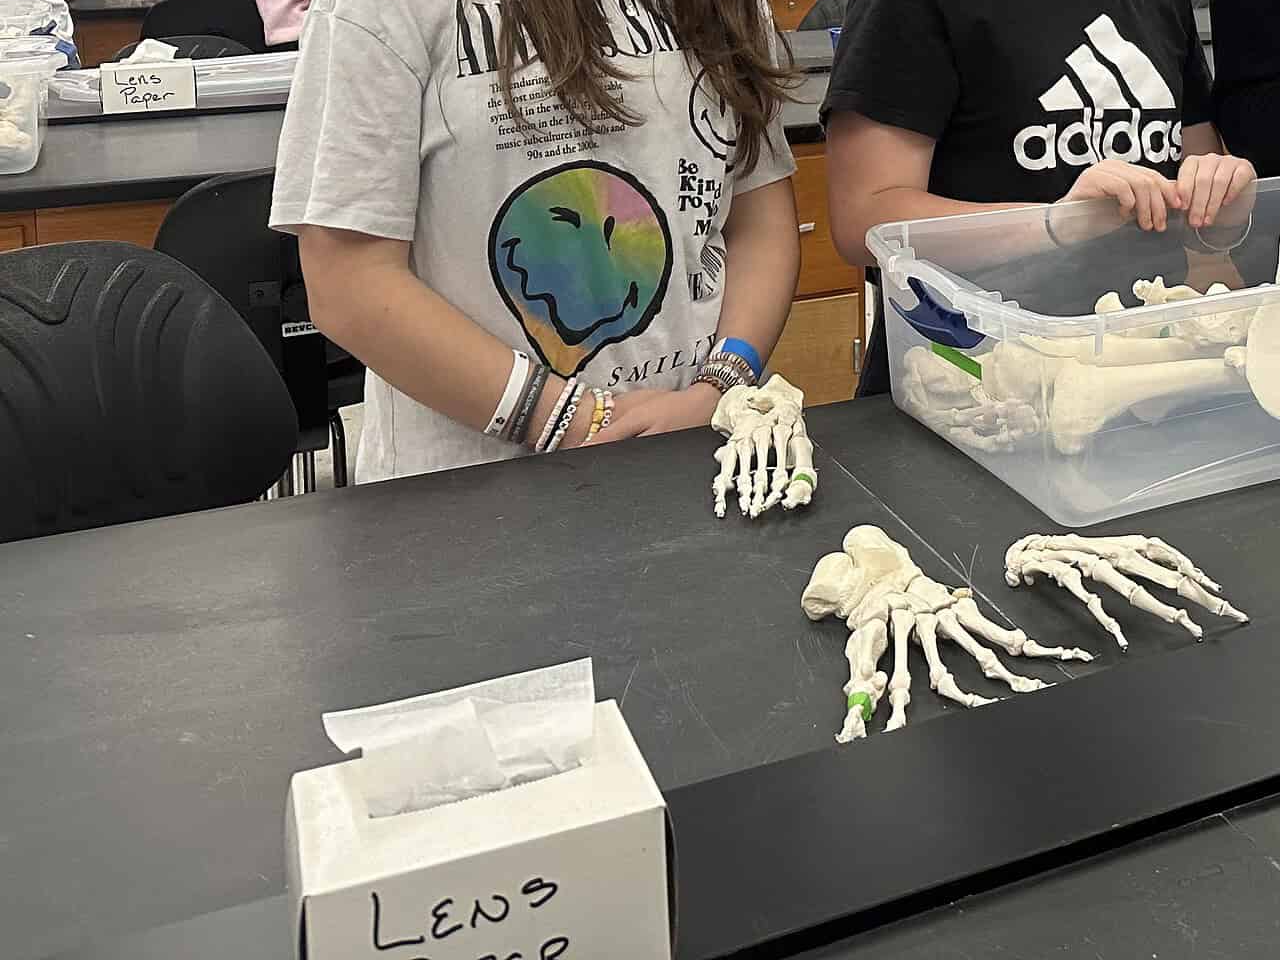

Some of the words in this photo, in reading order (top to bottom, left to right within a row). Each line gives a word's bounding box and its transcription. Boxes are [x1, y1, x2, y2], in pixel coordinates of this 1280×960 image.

[114, 71, 162, 86] Lens
[119, 86, 176, 109] Paper
[525, 107, 535, 117] in
[536, 102, 552, 114] the
[538, 120, 548, 129] in
[549, 115, 564, 127] the
[496, 140, 521, 151] music
[523, 131, 573, 147] subcultures
[1013, 107, 1182, 171] adidas
[527, 150, 543, 160] 90s
[544, 145, 561, 157] and
[562, 143, 576, 155] the
[678, 158, 698, 175] Be
[680, 175, 722, 200] Kind
[370, 877, 559, 951] LENS
